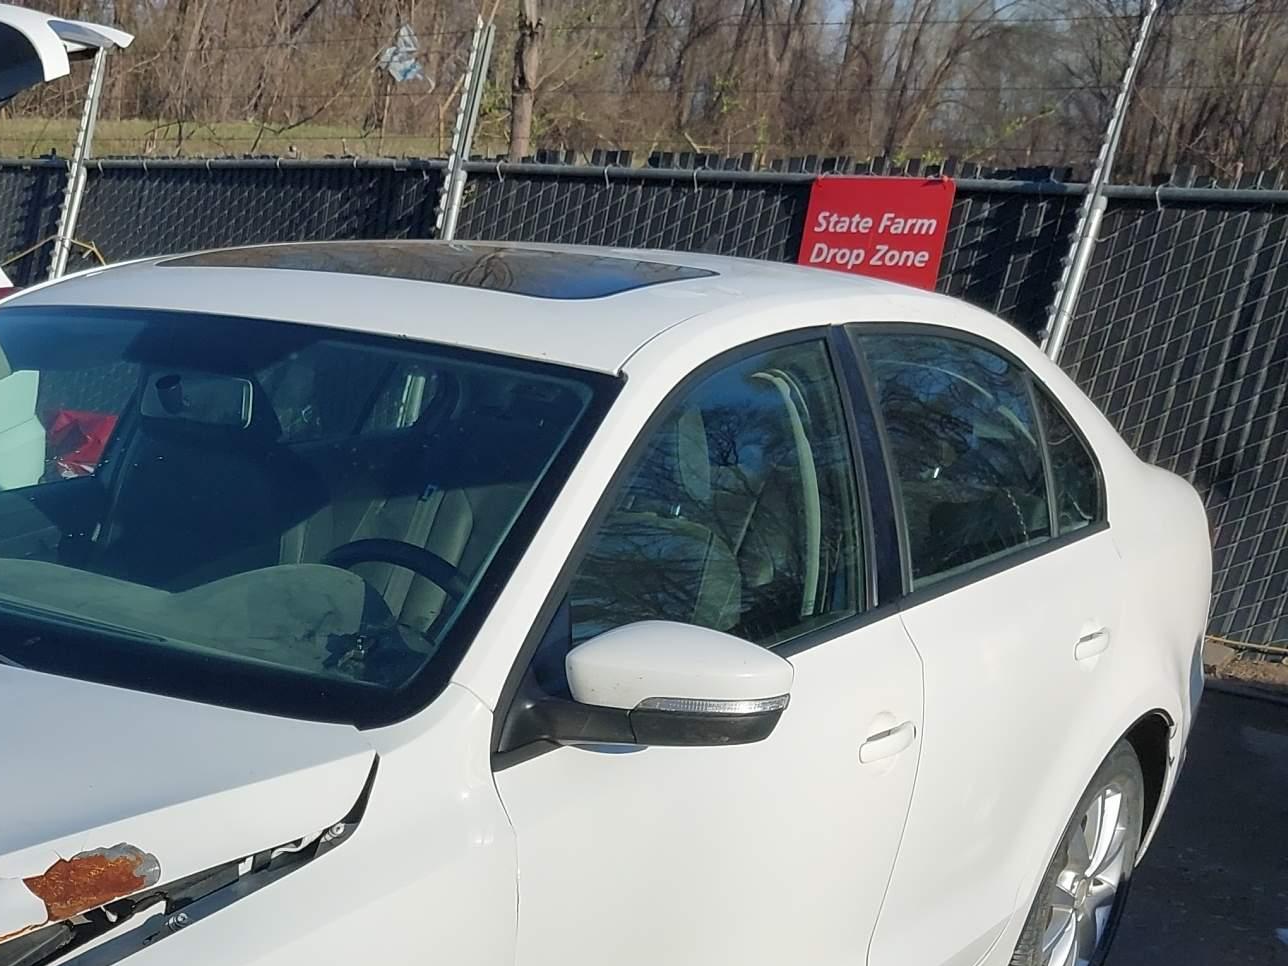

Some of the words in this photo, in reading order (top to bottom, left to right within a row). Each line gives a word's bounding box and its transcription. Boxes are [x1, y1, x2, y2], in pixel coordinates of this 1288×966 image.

[814, 211, 872, 234] State
[878, 213, 937, 236] Farm
[810, 243, 865, 270] Drop
[869, 244, 930, 268] Zone
